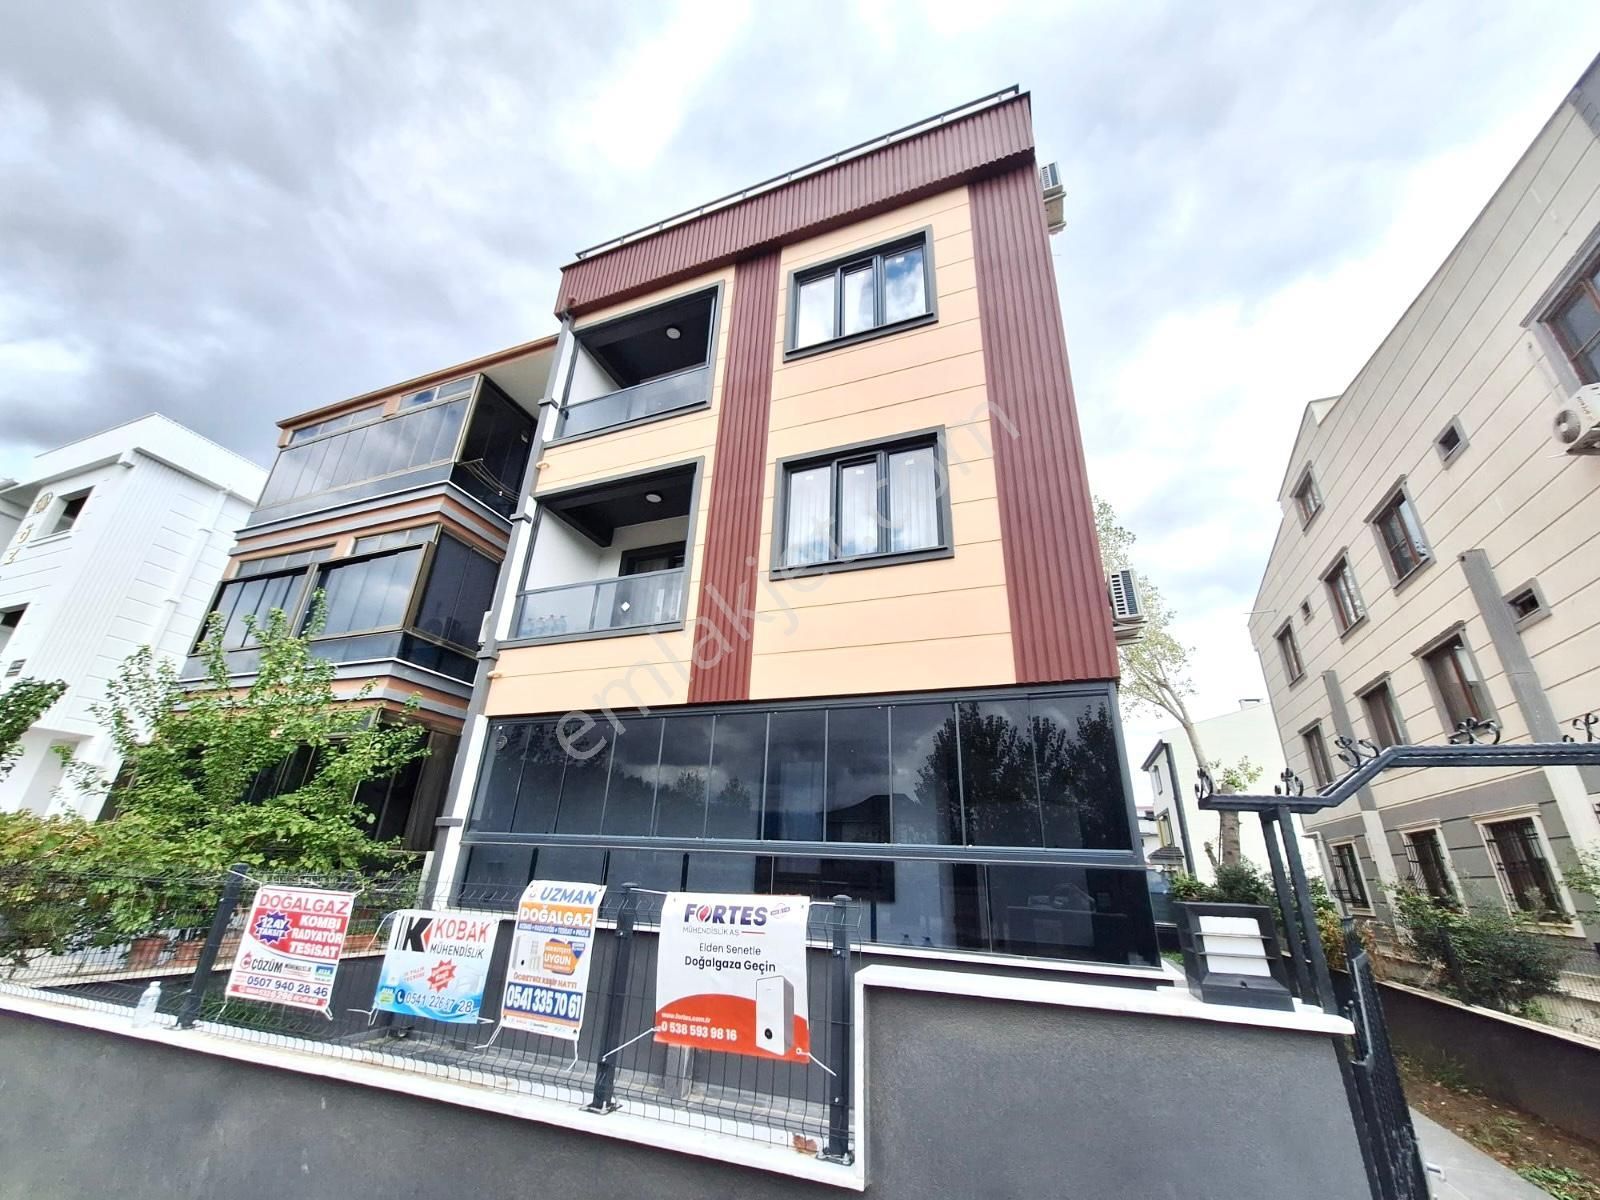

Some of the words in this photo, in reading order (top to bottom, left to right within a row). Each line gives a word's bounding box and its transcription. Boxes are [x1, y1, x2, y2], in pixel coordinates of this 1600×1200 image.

[260, 893, 350, 915] DOĞALGAZ
[540, 886, 598, 905] UZMAN
[262, 917, 273, 928] 12
[274, 919, 287, 929] AY
[520, 904, 593, 928] DOĞALGAZ
[684, 903, 768, 926] FORTES
[434, 919, 490, 943] KOBAK
[289, 941, 339, 959] TESİSAT
[699, 942, 724, 954] Elden
[726, 944, 762, 956] Senetle
[543, 953, 571, 966] UYGUN
[684, 955, 741, 971] Doğalgaza
[743, 960, 776, 975] Geçin
[247, 976, 272, 988] 0507
[275, 980, 294, 991] 940
[297, 983, 311, 994] 28
[314, 987, 328, 997] 46
[405, 992, 426, 1005] 0541
[458, 1000, 473, 1013] 28
[506, 984, 533, 1011] 0541
[532, 989, 554, 1014] 335
[553, 991, 568, 1016] 70
[568, 994, 581, 1019] 61
[661, 1021, 668, 1032] 0
[669, 1022, 688, 1035] 538
[689, 1024, 708, 1038] 593
[710, 1027, 724, 1040] 98
[726, 1028, 737, 1041] 16
